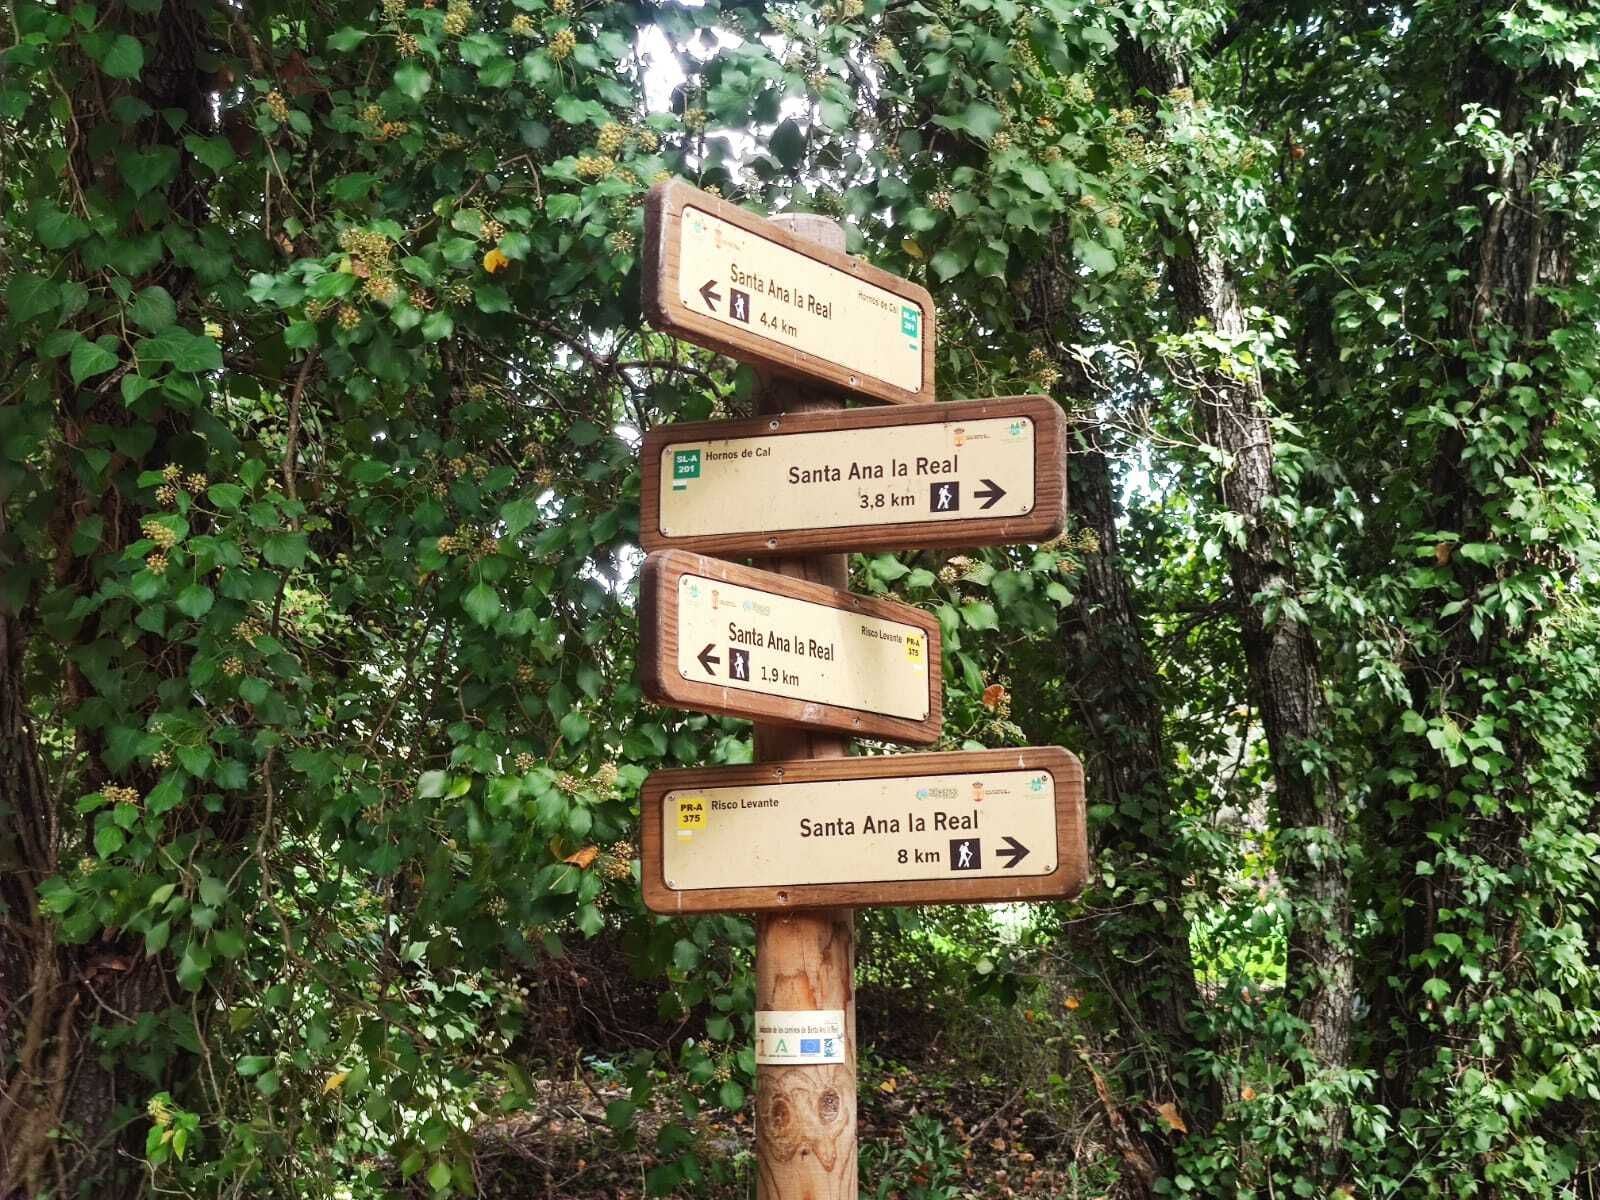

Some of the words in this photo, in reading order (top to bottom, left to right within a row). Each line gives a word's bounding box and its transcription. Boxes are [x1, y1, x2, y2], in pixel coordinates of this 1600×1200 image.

[730, 263, 764, 293] Santa
[768, 279, 790, 303] Ana
[794, 288, 804, 308] la
[808, 294, 832, 320] Real
[782, 319, 798, 337] km
[676, 455, 698, 463] SL-A
[705, 451, 738, 461] Hornos
[741, 448, 753, 458] de
[755, 447, 771, 457] Cal
[678, 465, 694, 473] 201
[788, 466, 841, 484] Santa
[848, 462, 884, 480] Ana
[892, 459, 908, 477] la
[916, 454, 958, 475] Real
[859, 494, 885, 509] 3,8
[891, 493, 915, 507] km
[728, 622, 764, 647] Santa
[767, 630, 790, 653] Ana
[794, 635, 805, 656] la
[808, 639, 834, 661] Real
[861, 626, 878, 638] Risco
[879, 630, 903, 643] Levante
[782, 670, 799, 687] km
[680, 804, 703, 812] PR-A
[711, 800, 738, 810] Risco
[741, 798, 779, 809] Levante
[683, 814, 701, 823] 375
[799, 818, 855, 838] Santa
[863, 815, 900, 834] Ana
[908, 813, 925, 832] la
[934, 810, 978, 831] Real
[897, 849, 908, 864] 8
[914, 848, 940, 863] km
